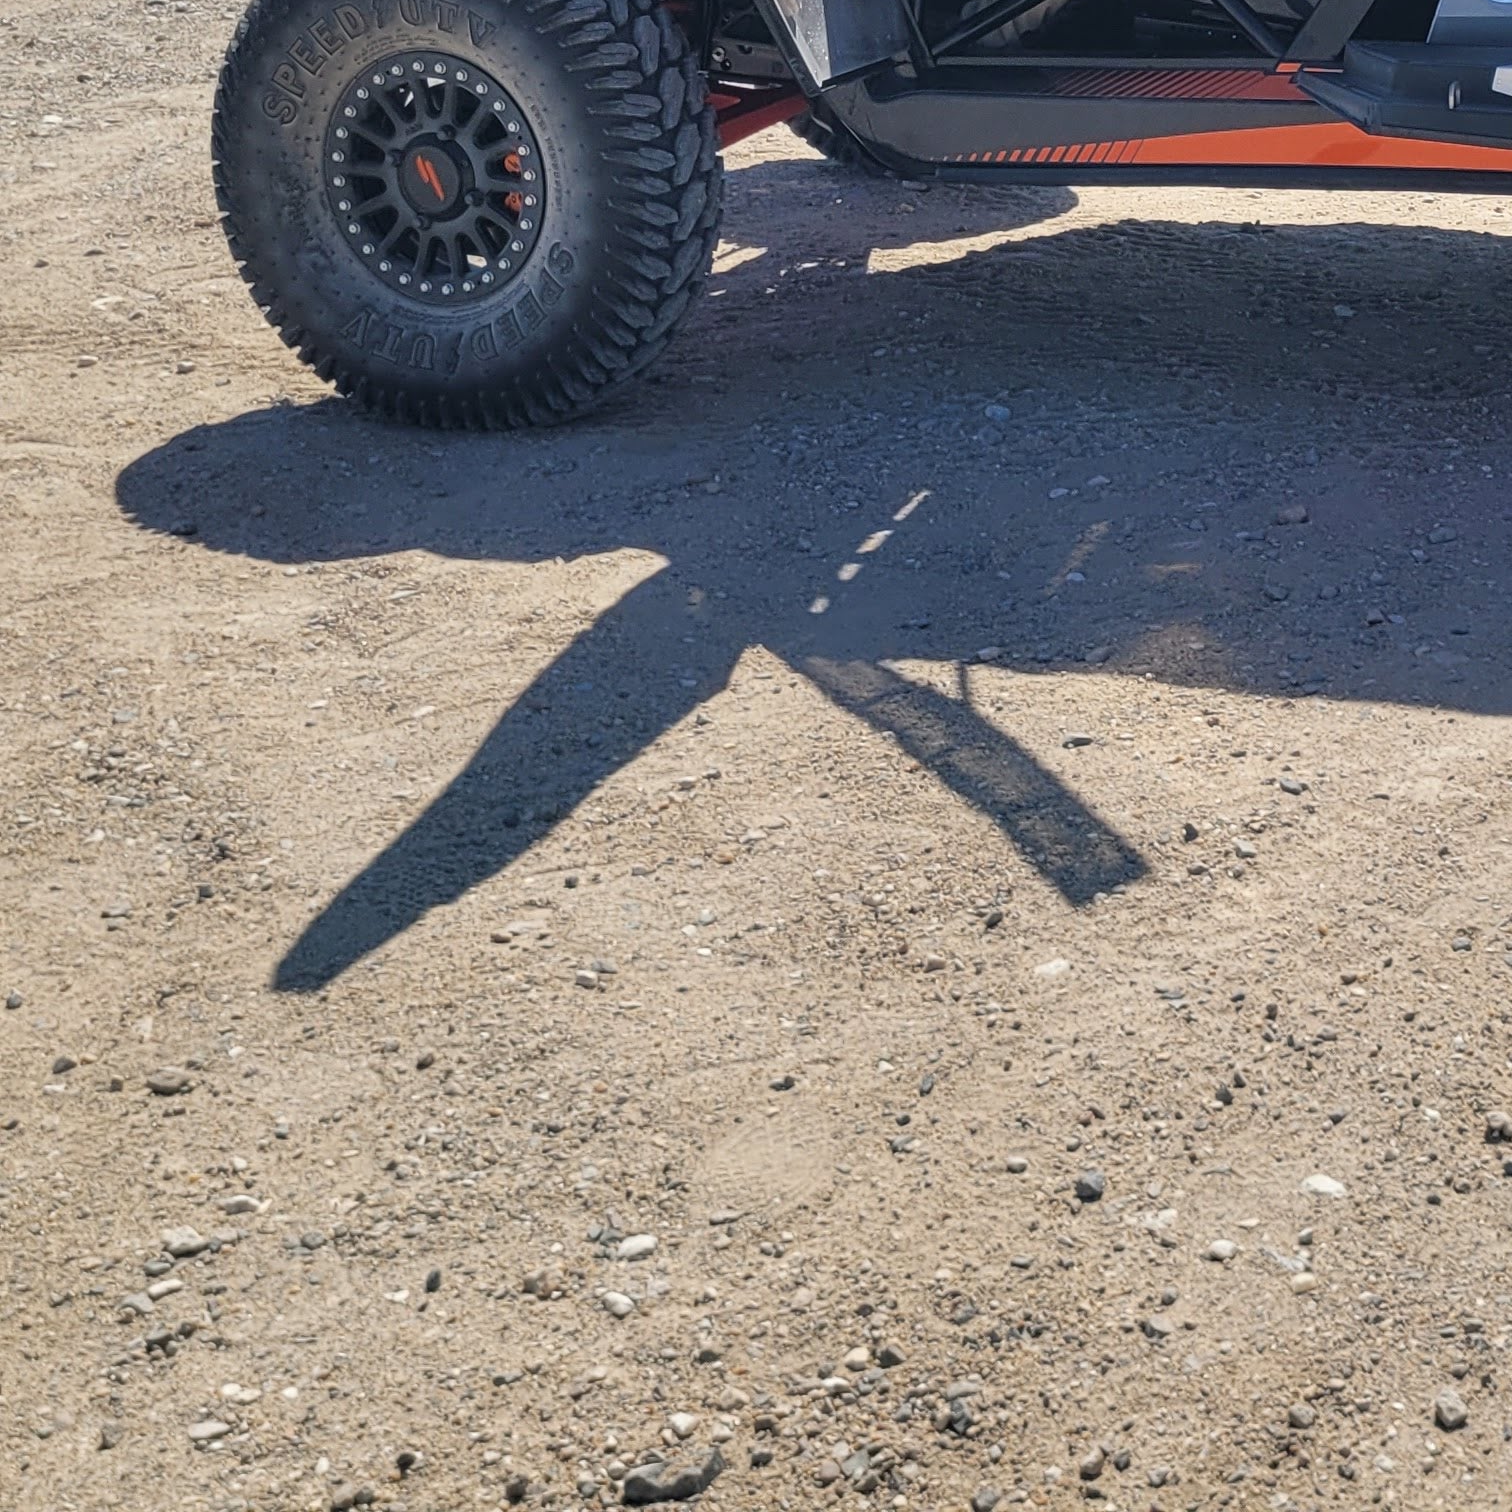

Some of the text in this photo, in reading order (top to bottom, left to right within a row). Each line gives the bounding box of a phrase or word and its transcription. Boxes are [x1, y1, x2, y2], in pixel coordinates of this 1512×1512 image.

[262, 2, 369, 127] SPEED
[337, 308, 436, 372] UTV
[470, 239, 576, 362] SPEED
